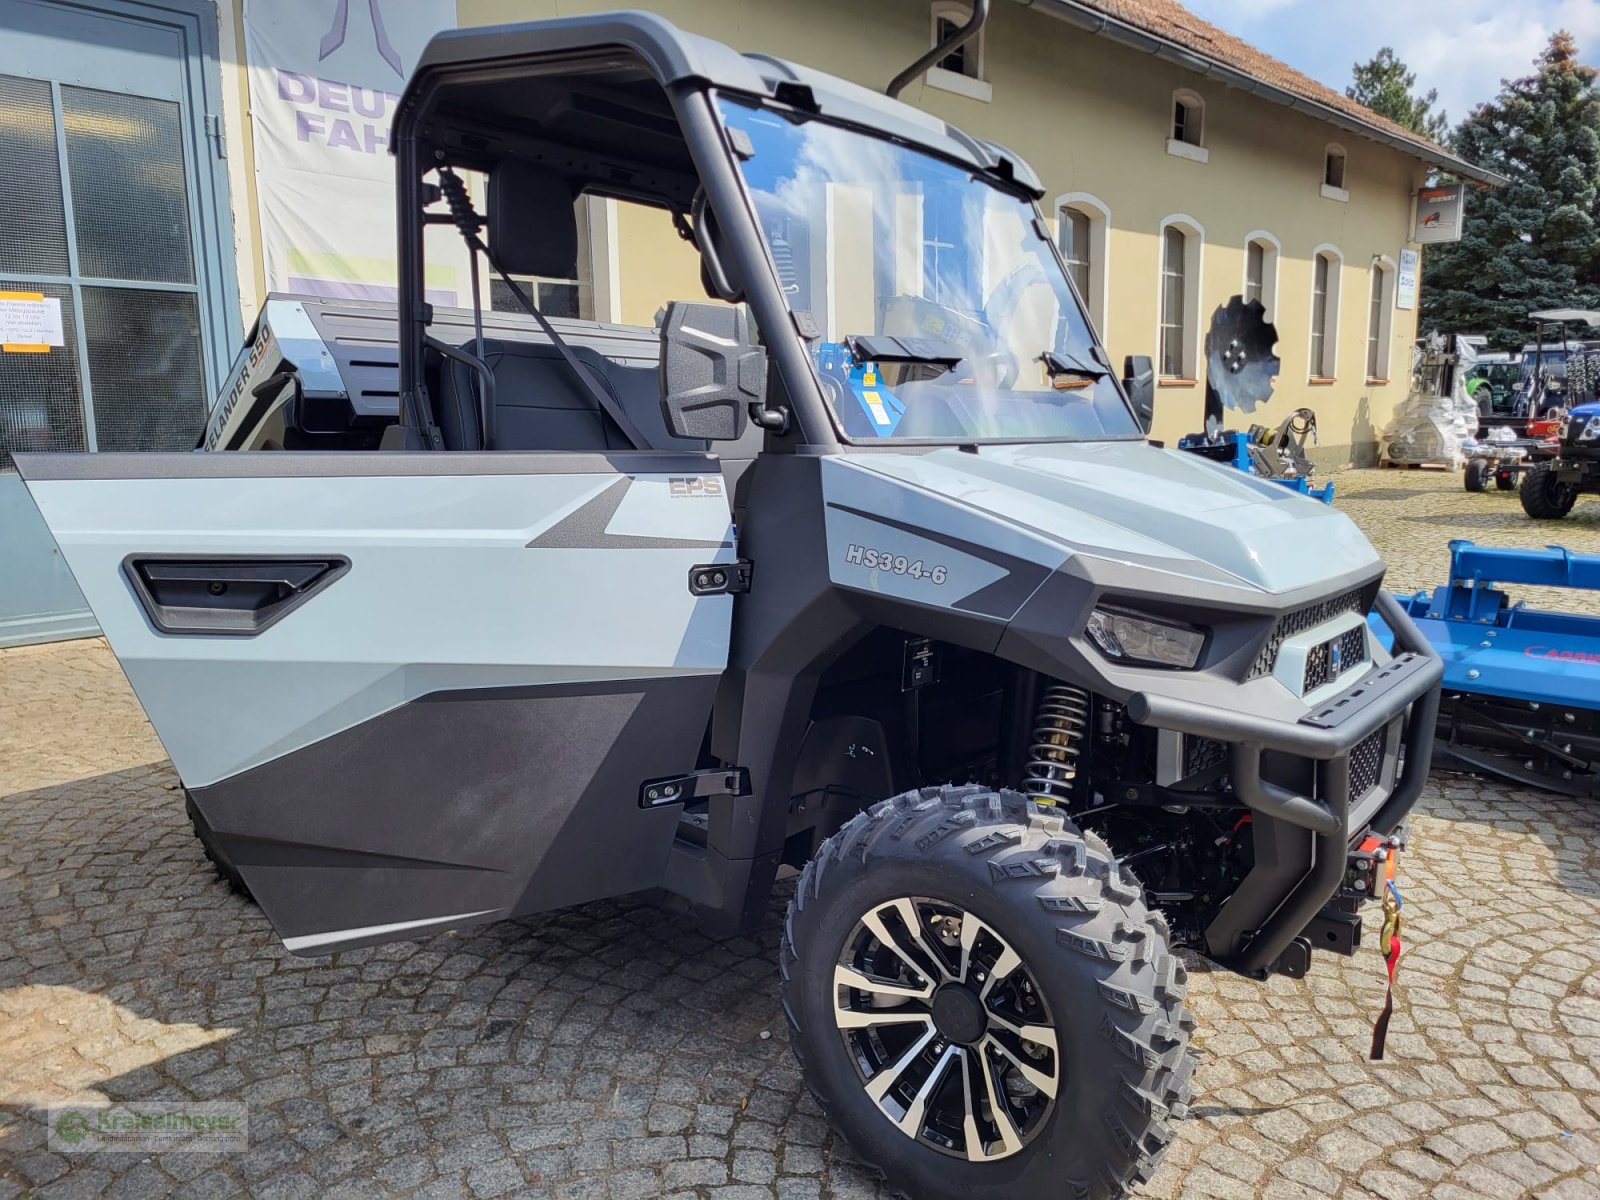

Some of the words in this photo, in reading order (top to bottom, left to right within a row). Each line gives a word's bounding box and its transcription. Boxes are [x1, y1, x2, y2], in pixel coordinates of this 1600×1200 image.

[249, 324, 271, 368] 550
[669, 477, 721, 494] EPS
[846, 544, 947, 585] HS394-6
